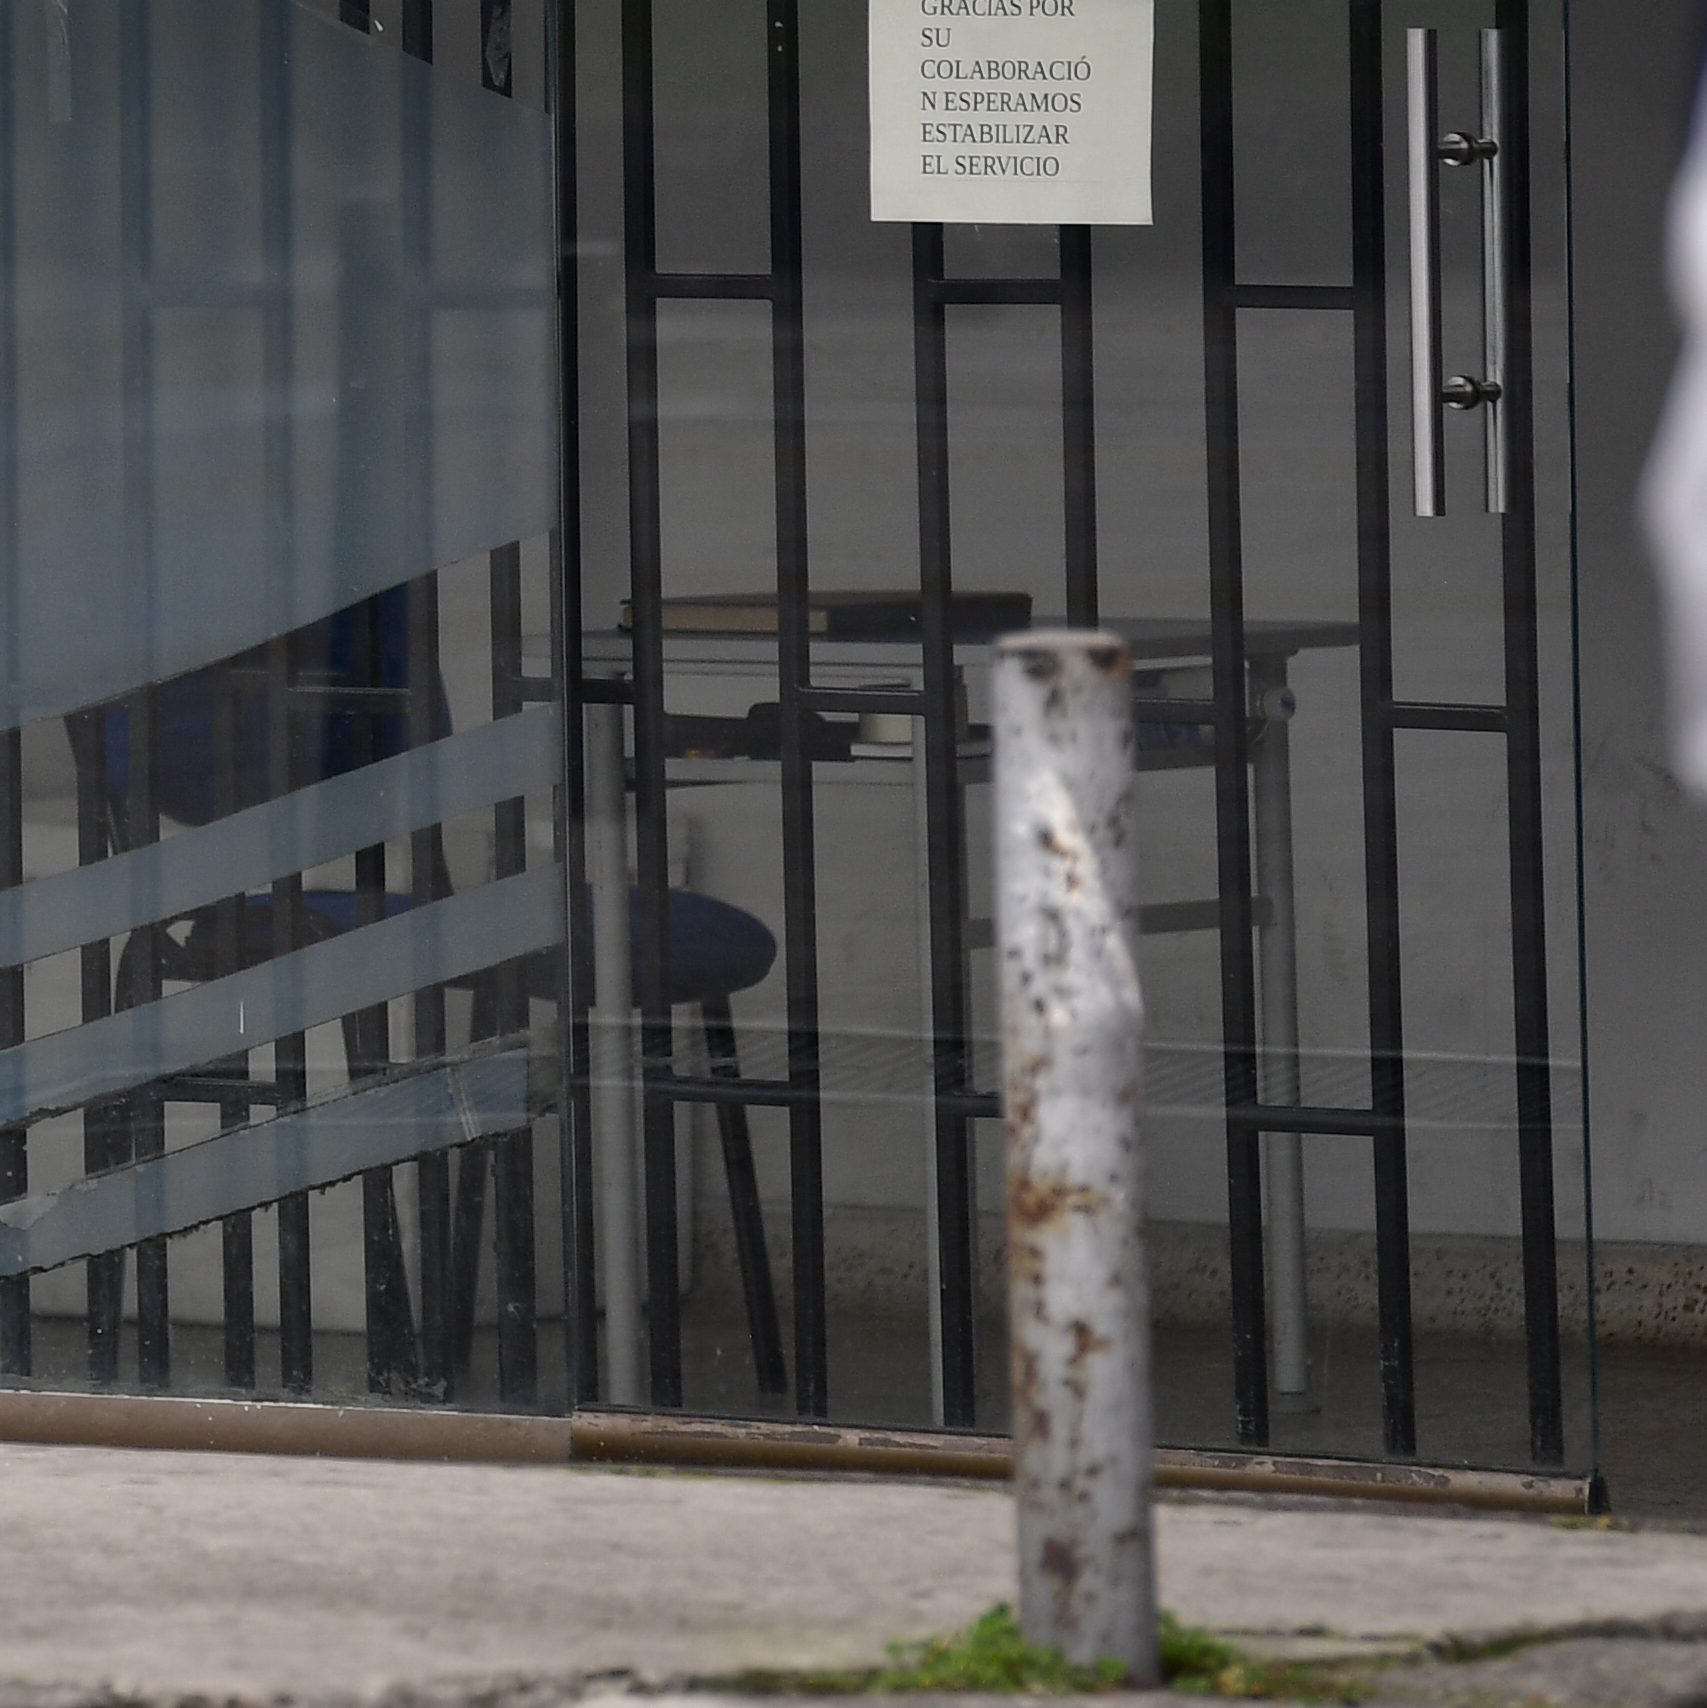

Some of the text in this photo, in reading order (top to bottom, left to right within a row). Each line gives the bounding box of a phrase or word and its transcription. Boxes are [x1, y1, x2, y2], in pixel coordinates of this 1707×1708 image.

[920, 27, 951, 48] SU
[920, 56, 1092, 81] COLABORACIÓ
[920, 91, 1082, 113] N ESPERAMOS
[921, 123, 1070, 144] ESTABILIZAR
[921, 154, 1060, 176] EL SERVICIO
